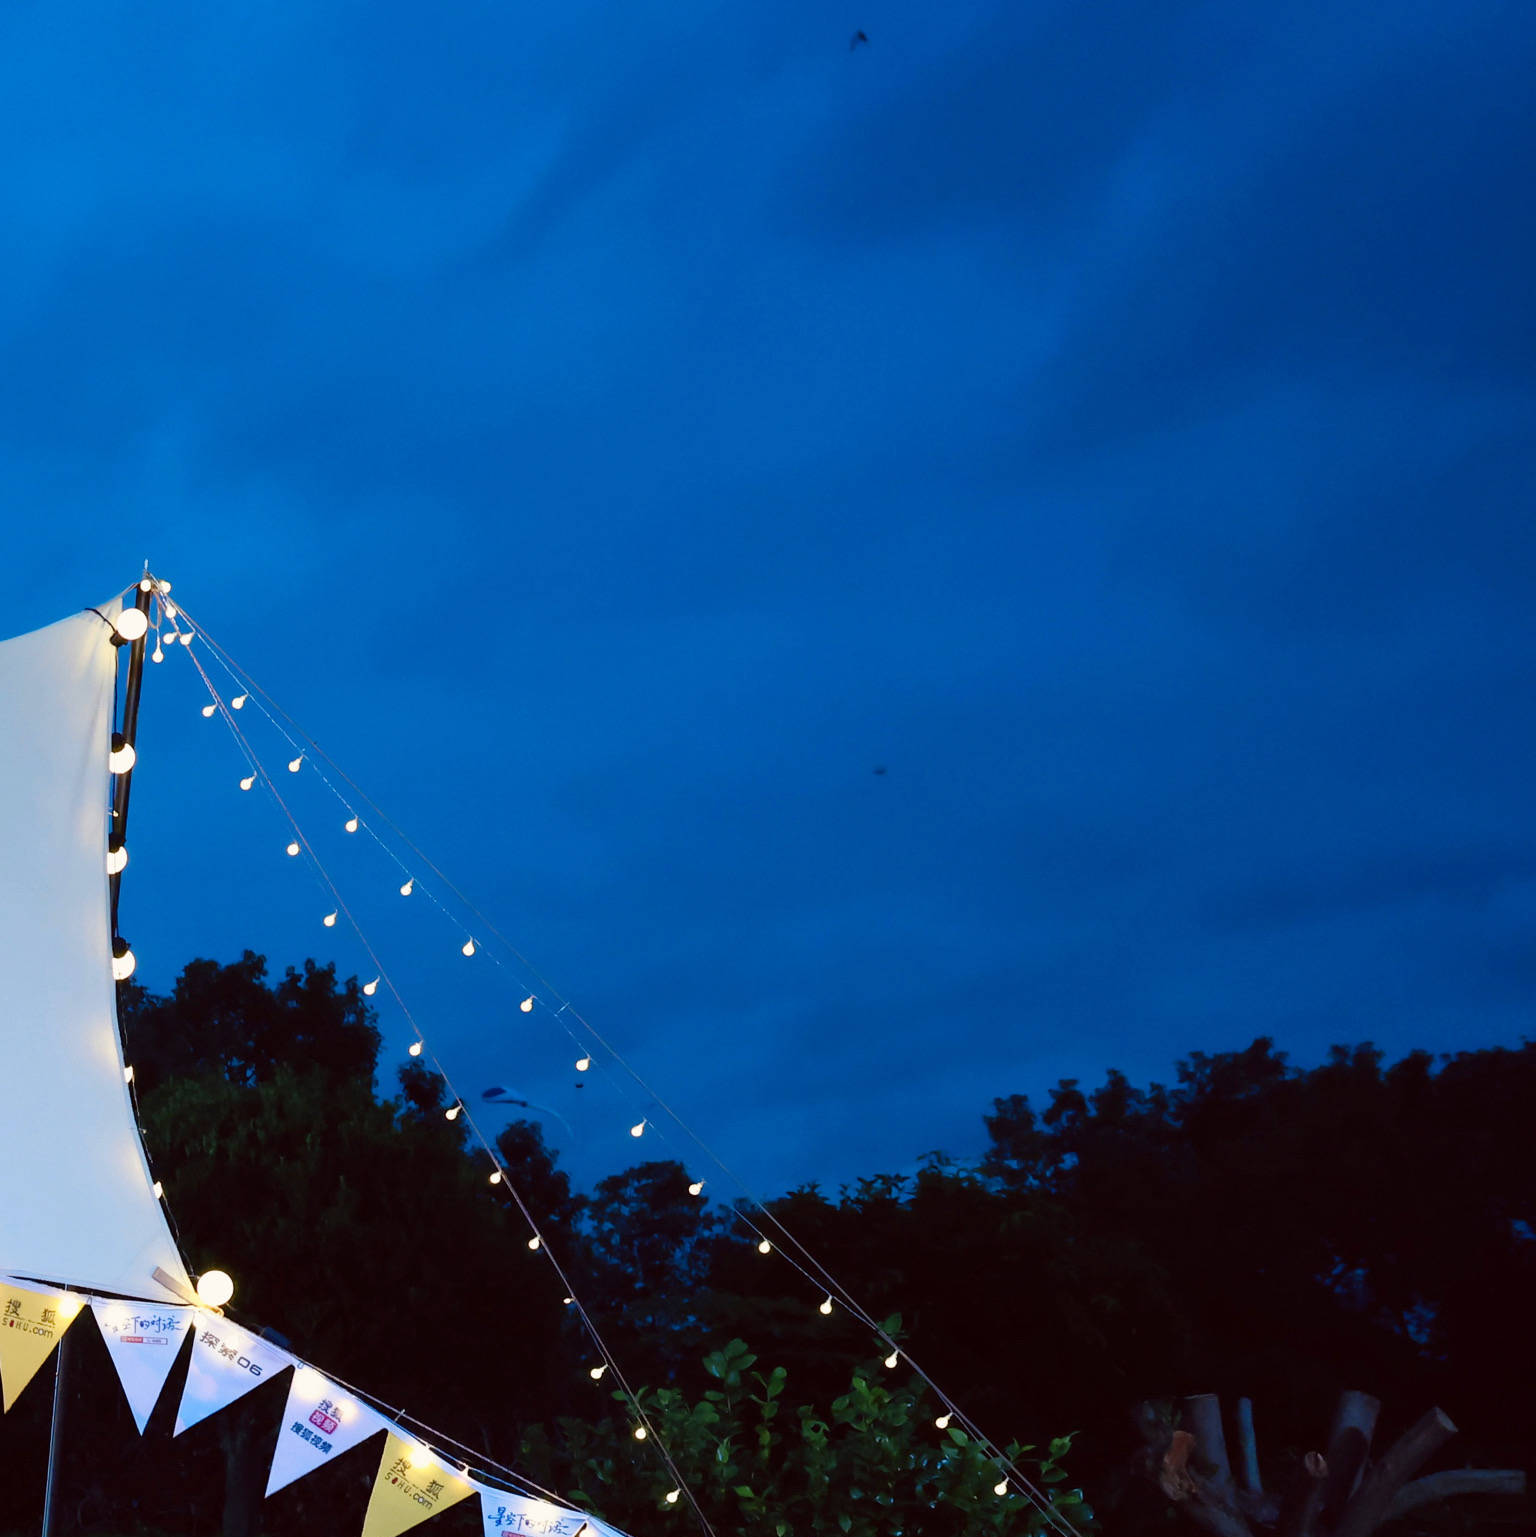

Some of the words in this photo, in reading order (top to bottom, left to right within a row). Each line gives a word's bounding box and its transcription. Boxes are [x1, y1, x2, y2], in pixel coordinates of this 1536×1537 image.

[199, 1331, 262, 1376] 探索06
[290, 1422, 332, 1454] 搜狐视频
